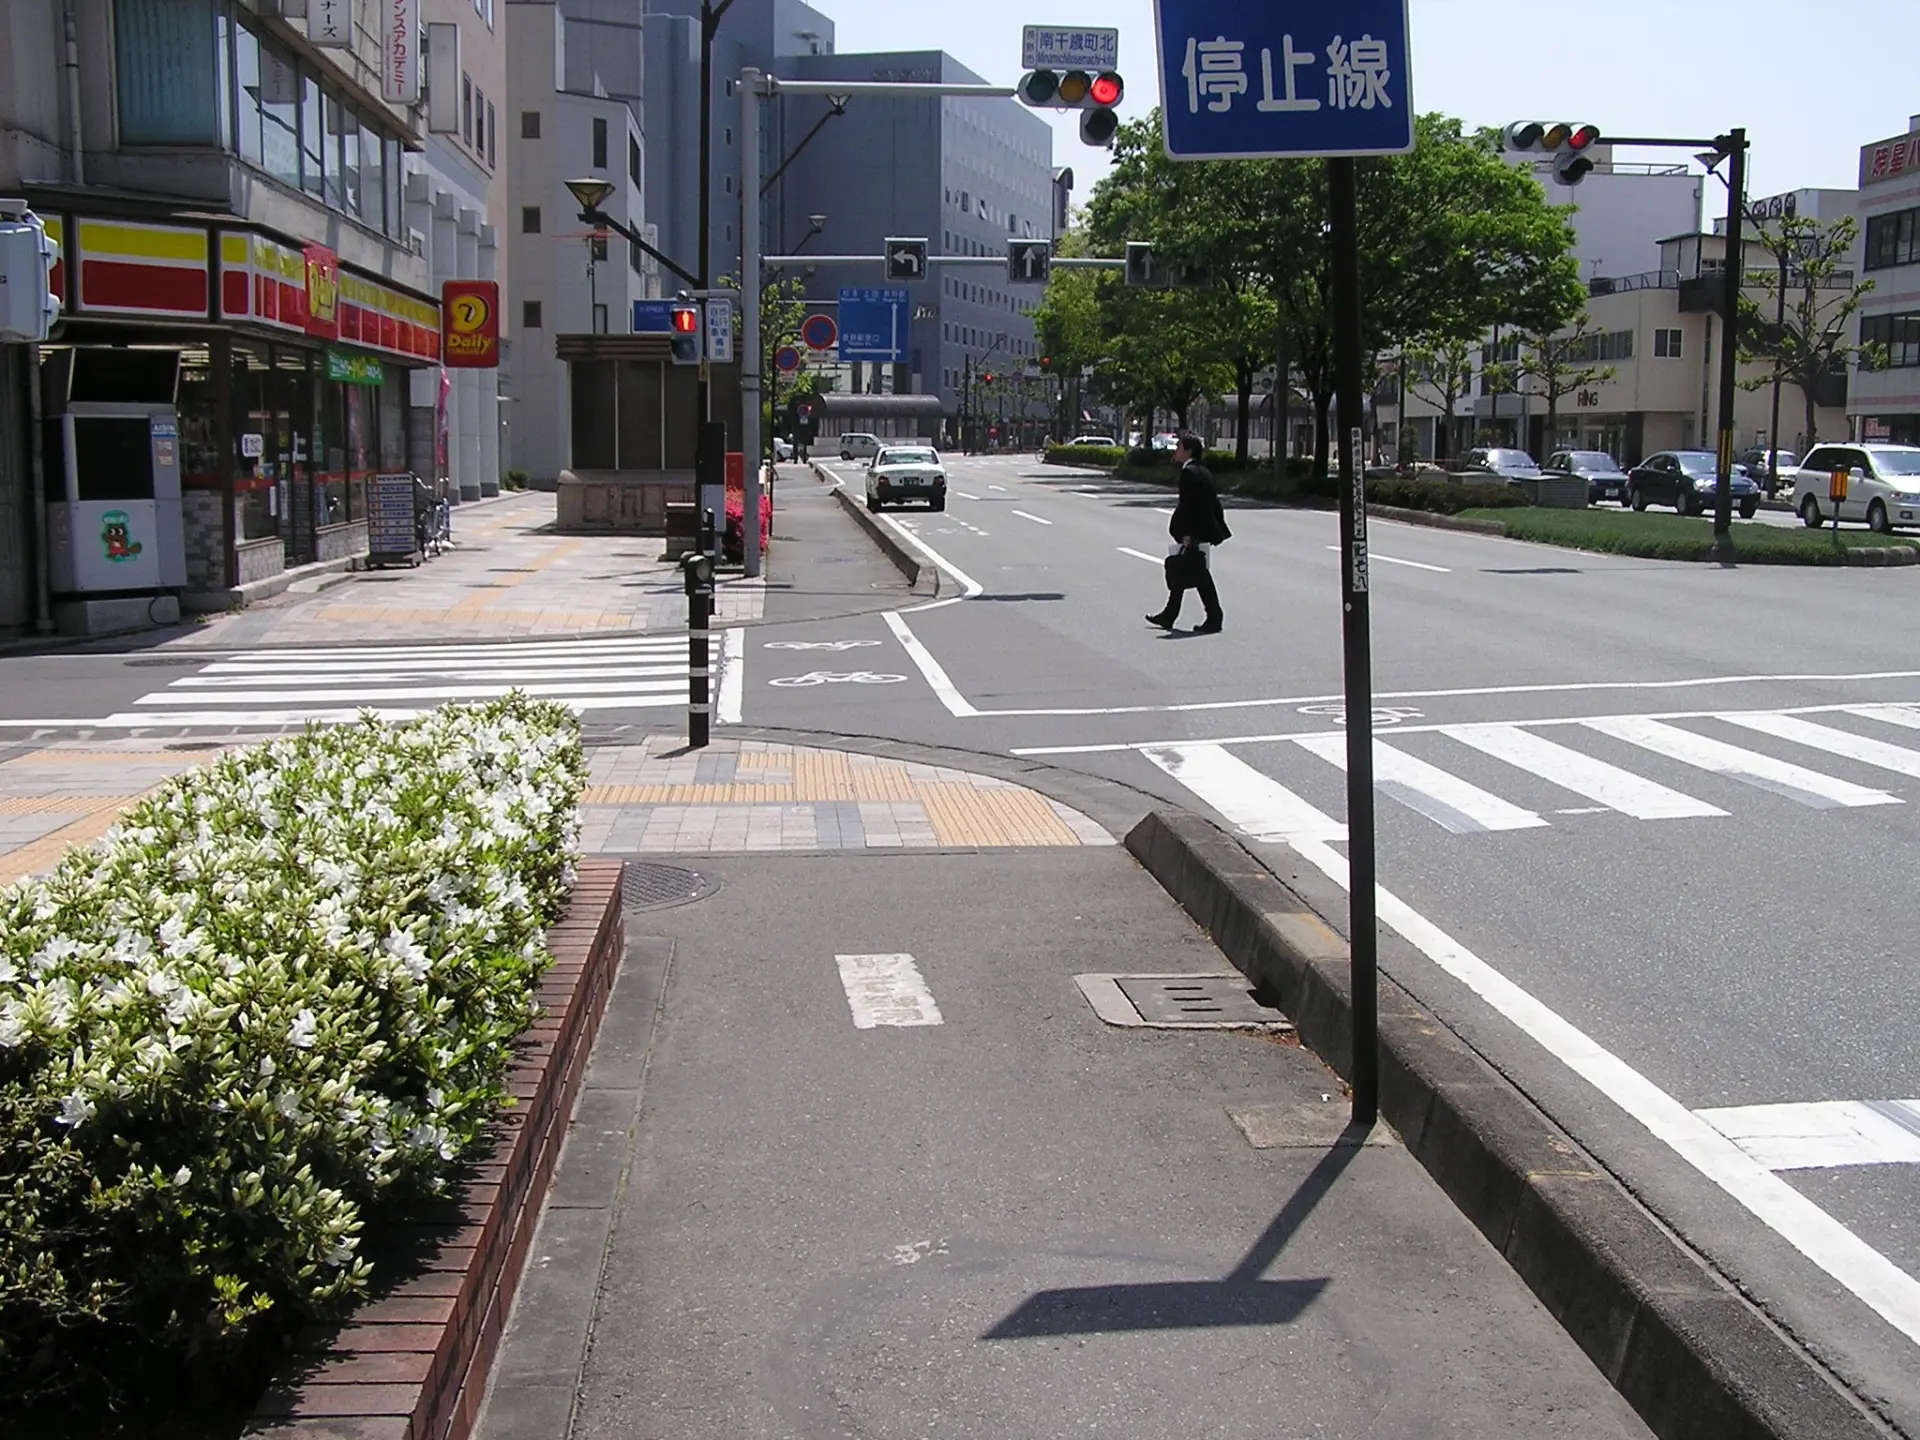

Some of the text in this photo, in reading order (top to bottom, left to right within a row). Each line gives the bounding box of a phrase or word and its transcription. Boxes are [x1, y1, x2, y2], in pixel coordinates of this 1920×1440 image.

[1039, 31, 1114, 51] 南千歳町北
[1181, 33, 1392, 113] 停止線
[447, 332, 492, 356] Daily
